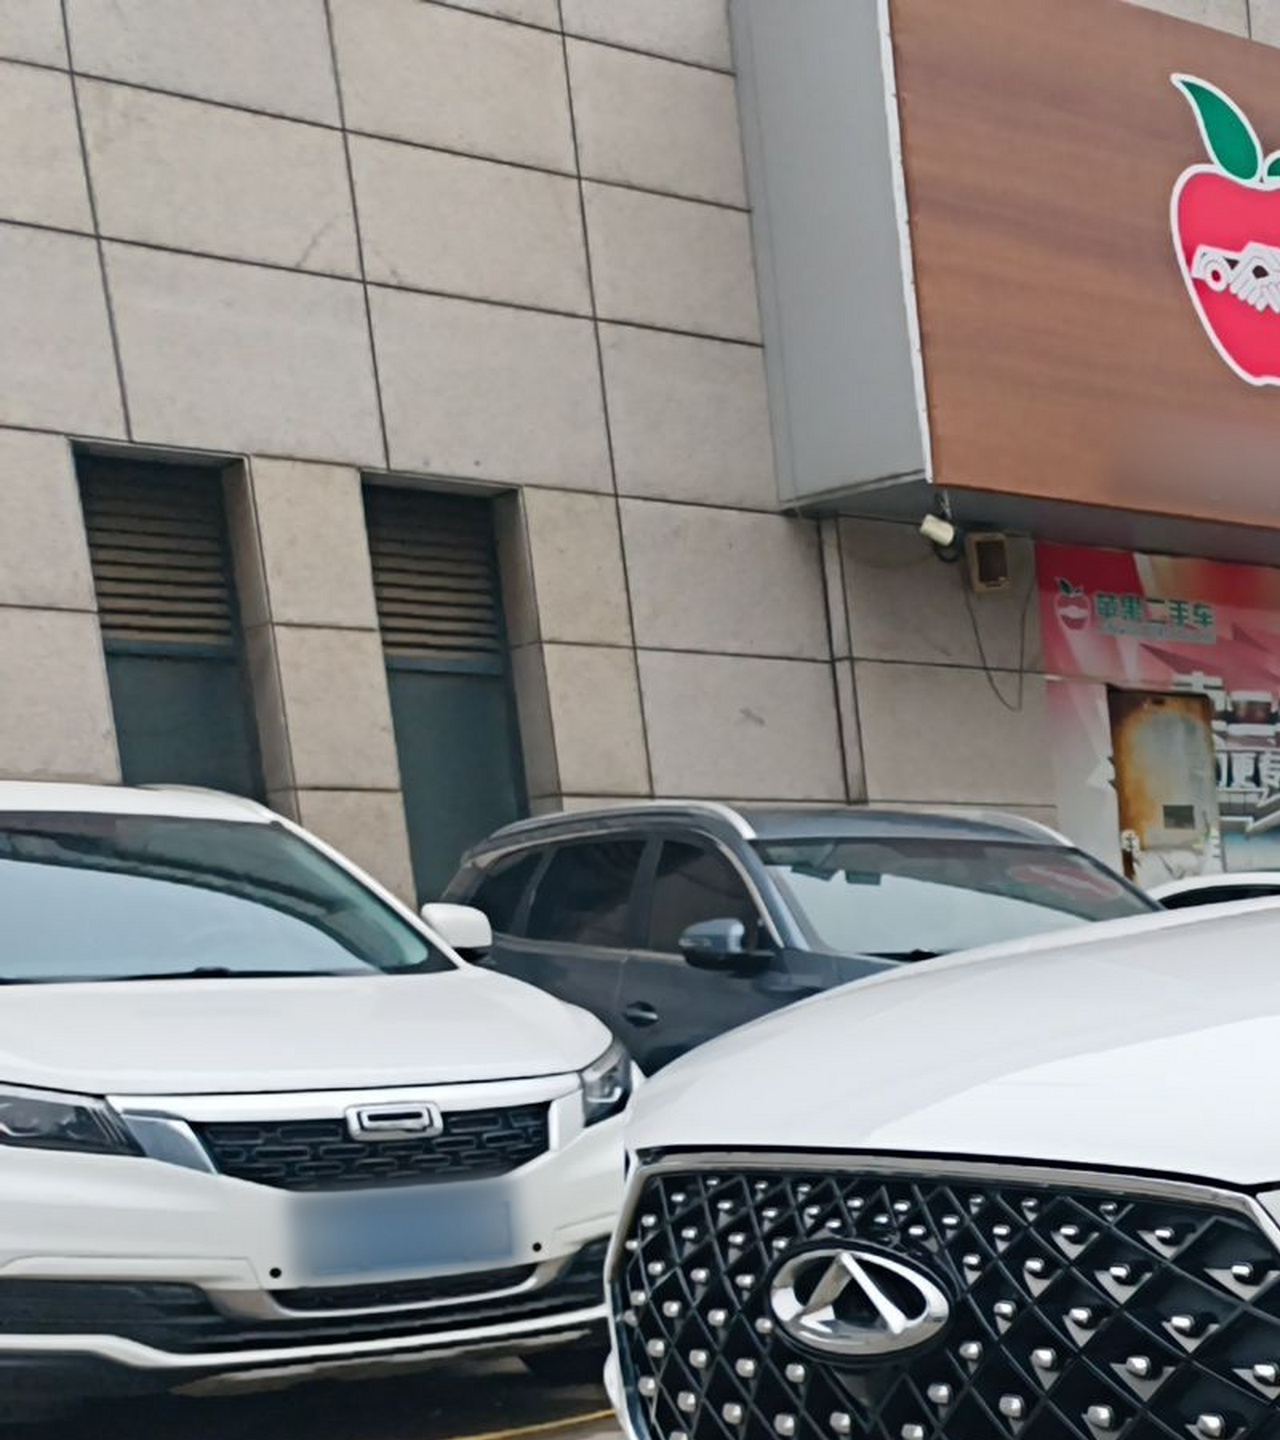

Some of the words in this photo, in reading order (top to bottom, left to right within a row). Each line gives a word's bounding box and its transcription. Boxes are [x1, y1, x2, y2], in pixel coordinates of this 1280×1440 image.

[1096, 593, 1213, 627] 苹果二手车
